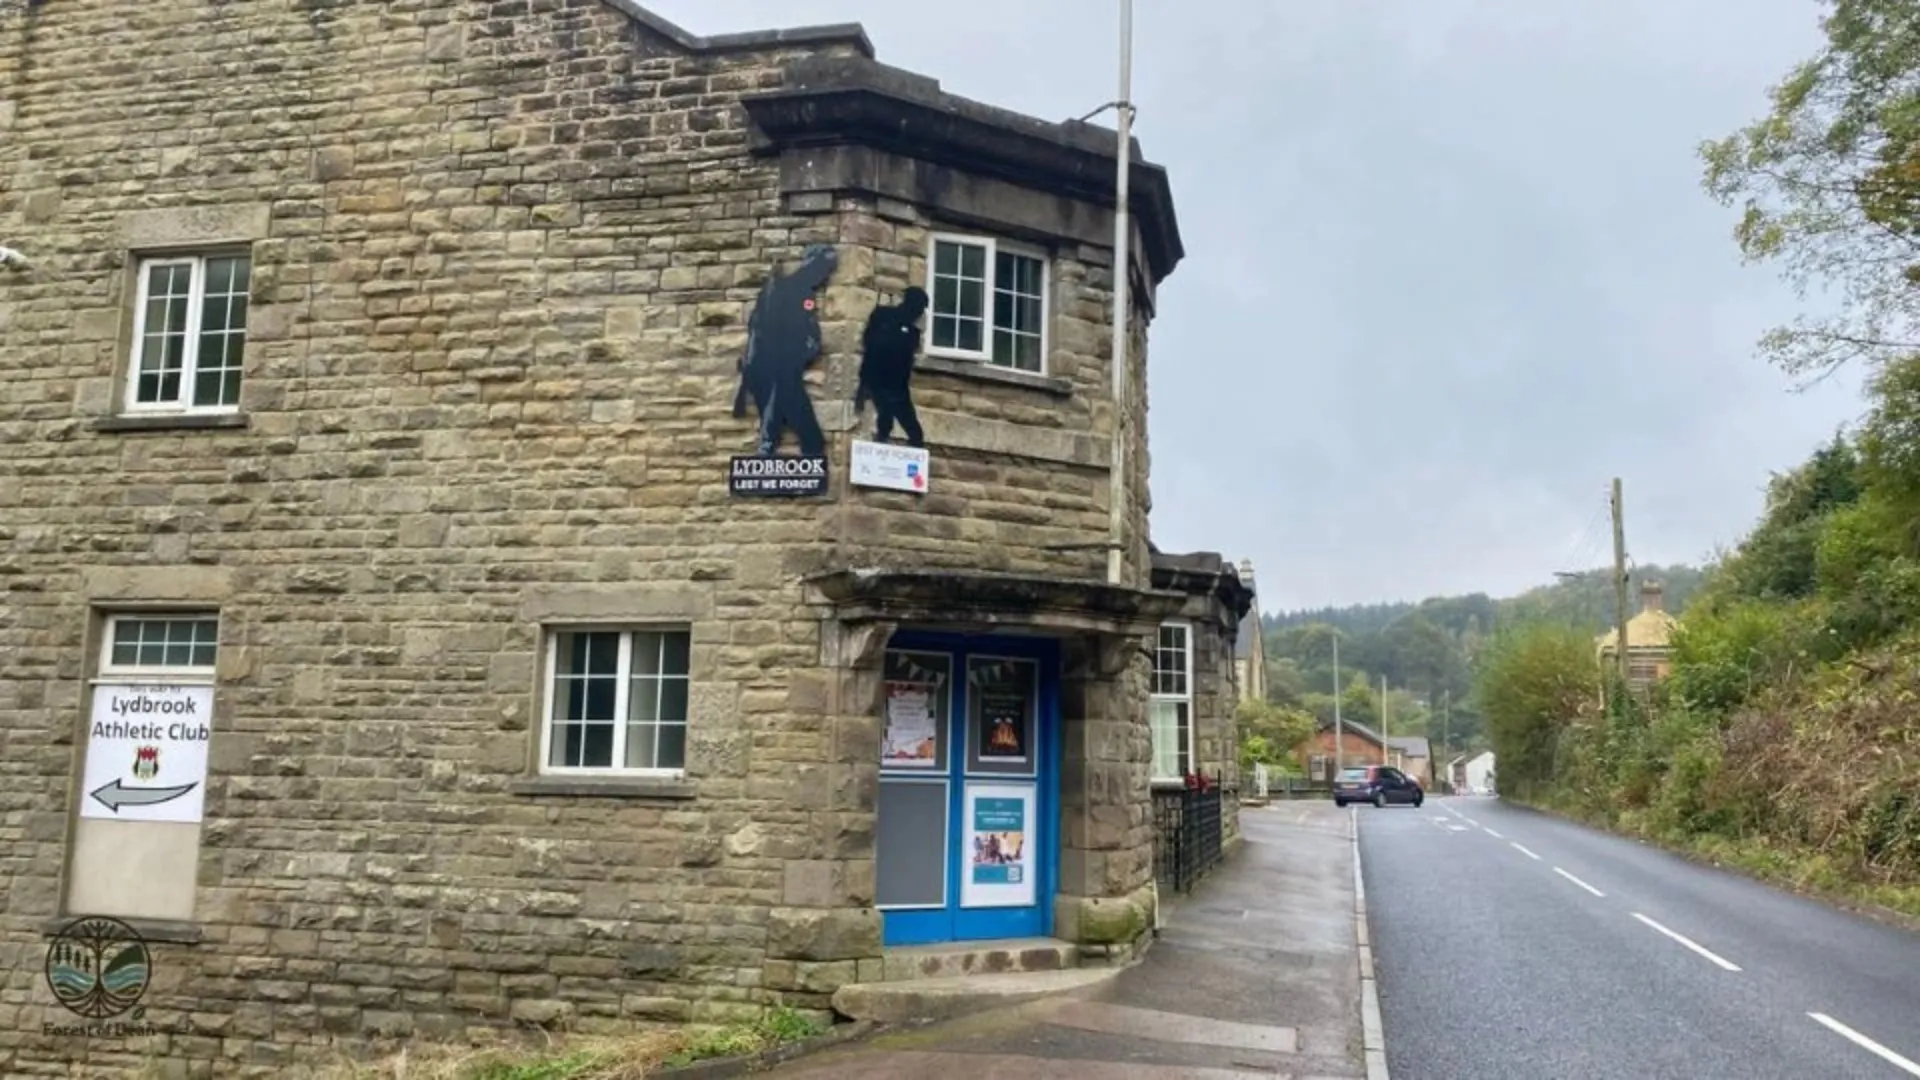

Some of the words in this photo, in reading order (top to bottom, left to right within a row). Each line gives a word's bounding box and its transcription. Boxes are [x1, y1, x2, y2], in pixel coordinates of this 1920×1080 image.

[733, 459, 824, 475] LYDBROOK
[735, 479, 760, 489] LEST
[762, 479, 778, 489] WE
[780, 479, 820, 489] FORGET
[111, 695, 196, 717] Lydbrook
[92, 721, 163, 740] Athletic
[168, 722, 210, 741] Club
